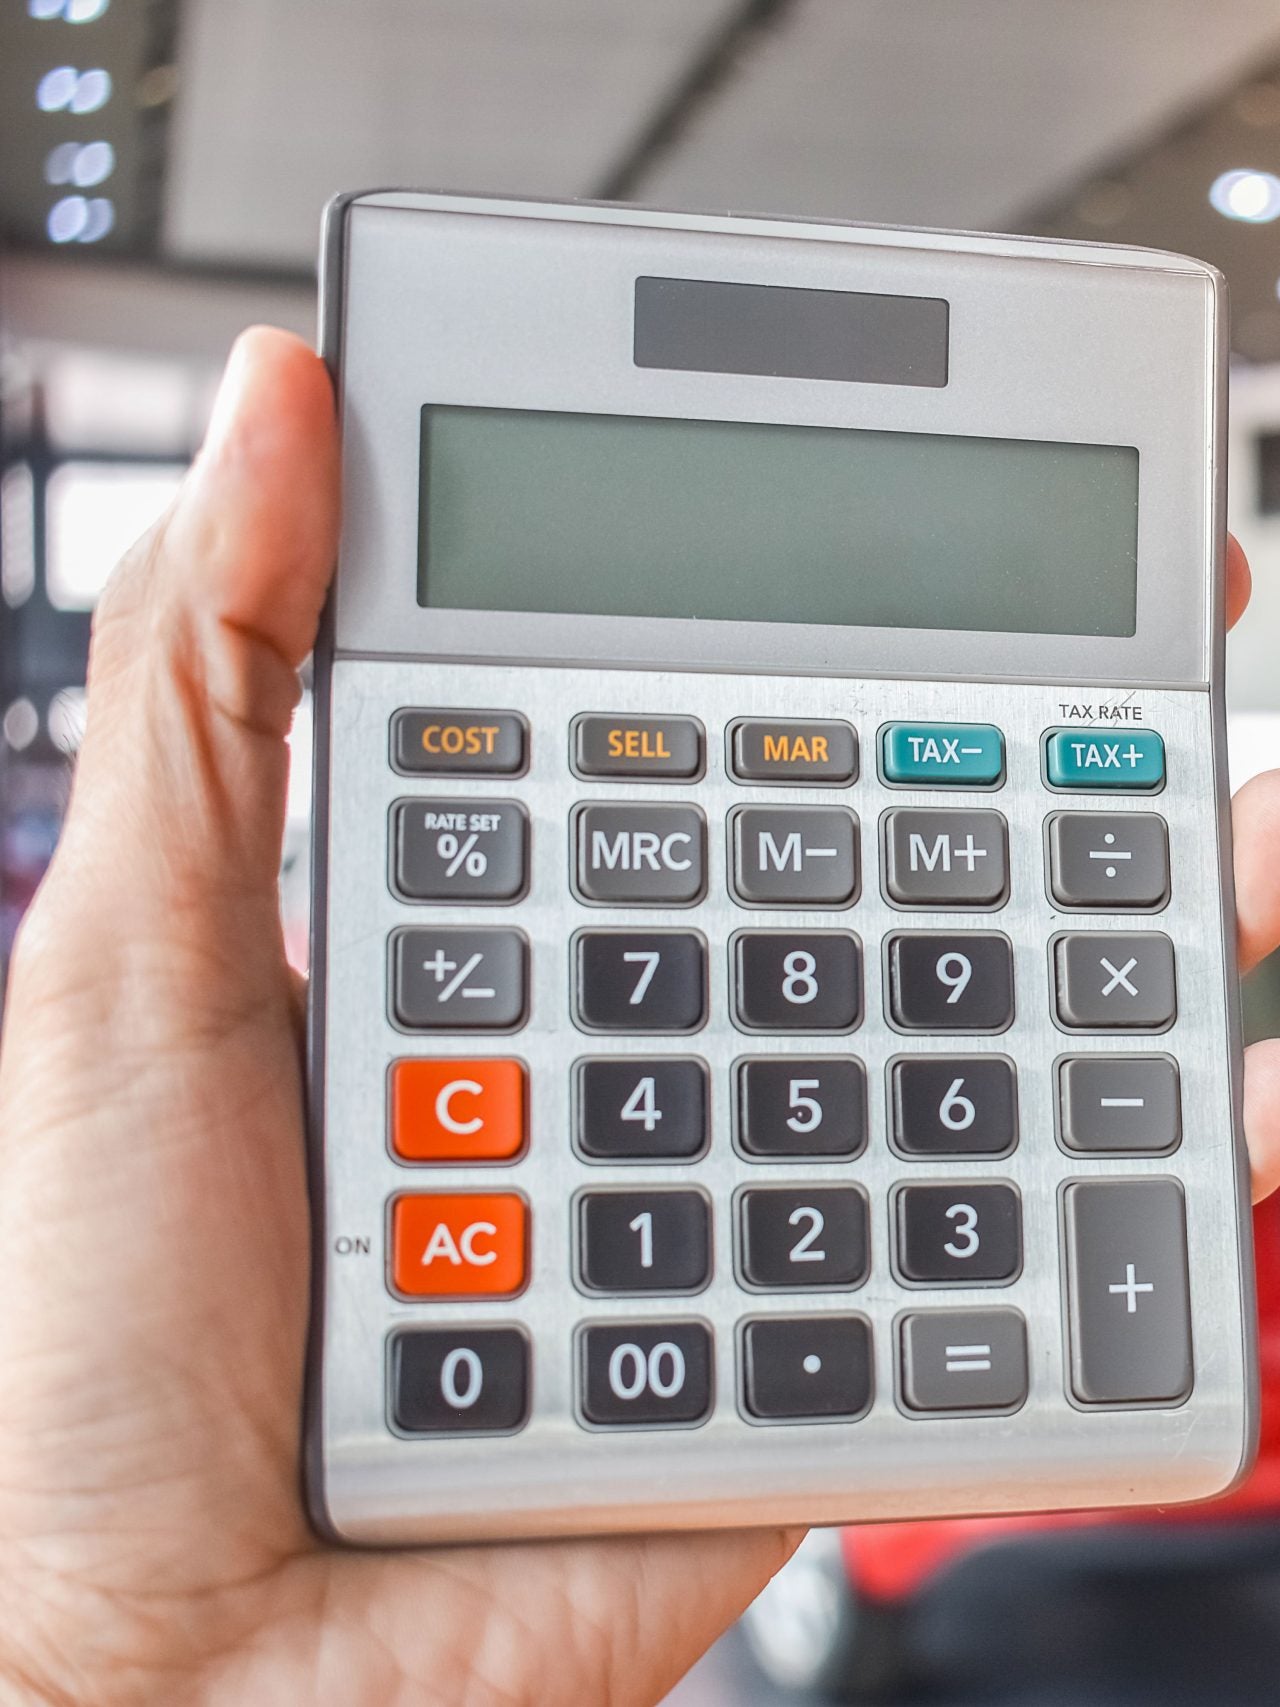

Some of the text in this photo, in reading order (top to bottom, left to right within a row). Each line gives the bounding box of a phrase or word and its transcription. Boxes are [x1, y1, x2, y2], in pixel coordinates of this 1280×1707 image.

[1060, 705, 1143, 722] TAX RATE
[423, 726, 500, 755] COST
[609, 730, 671, 758] SELL
[765, 736, 829, 763] MAR
[1072, 744, 1144, 769] TAX+
[426, 814, 501, 833] RATE SET
[438, 835, 488, 878] %
[593, 832, 693, 872] MRC
[910, 835, 988, 873] M+
[624, 953, 661, 1005] 7
[783, 952, 820, 1004] 8
[936, 953, 973, 1004] 9
[437, 1081, 485, 1135] C
[622, 1078, 663, 1132] 4
[787, 1080, 823, 1134] 5
[940, 1079, 976, 1132] 6
[336, 1237, 372, 1257] ON
[422, 1223, 498, 1267] AC
[630, 1214, 653, 1269] 1
[789, 1207, 827, 1263] 2
[945, 1204, 981, 1259] 3
[442, 1349, 484, 1410] 0
[610, 1343, 686, 1401] 00
